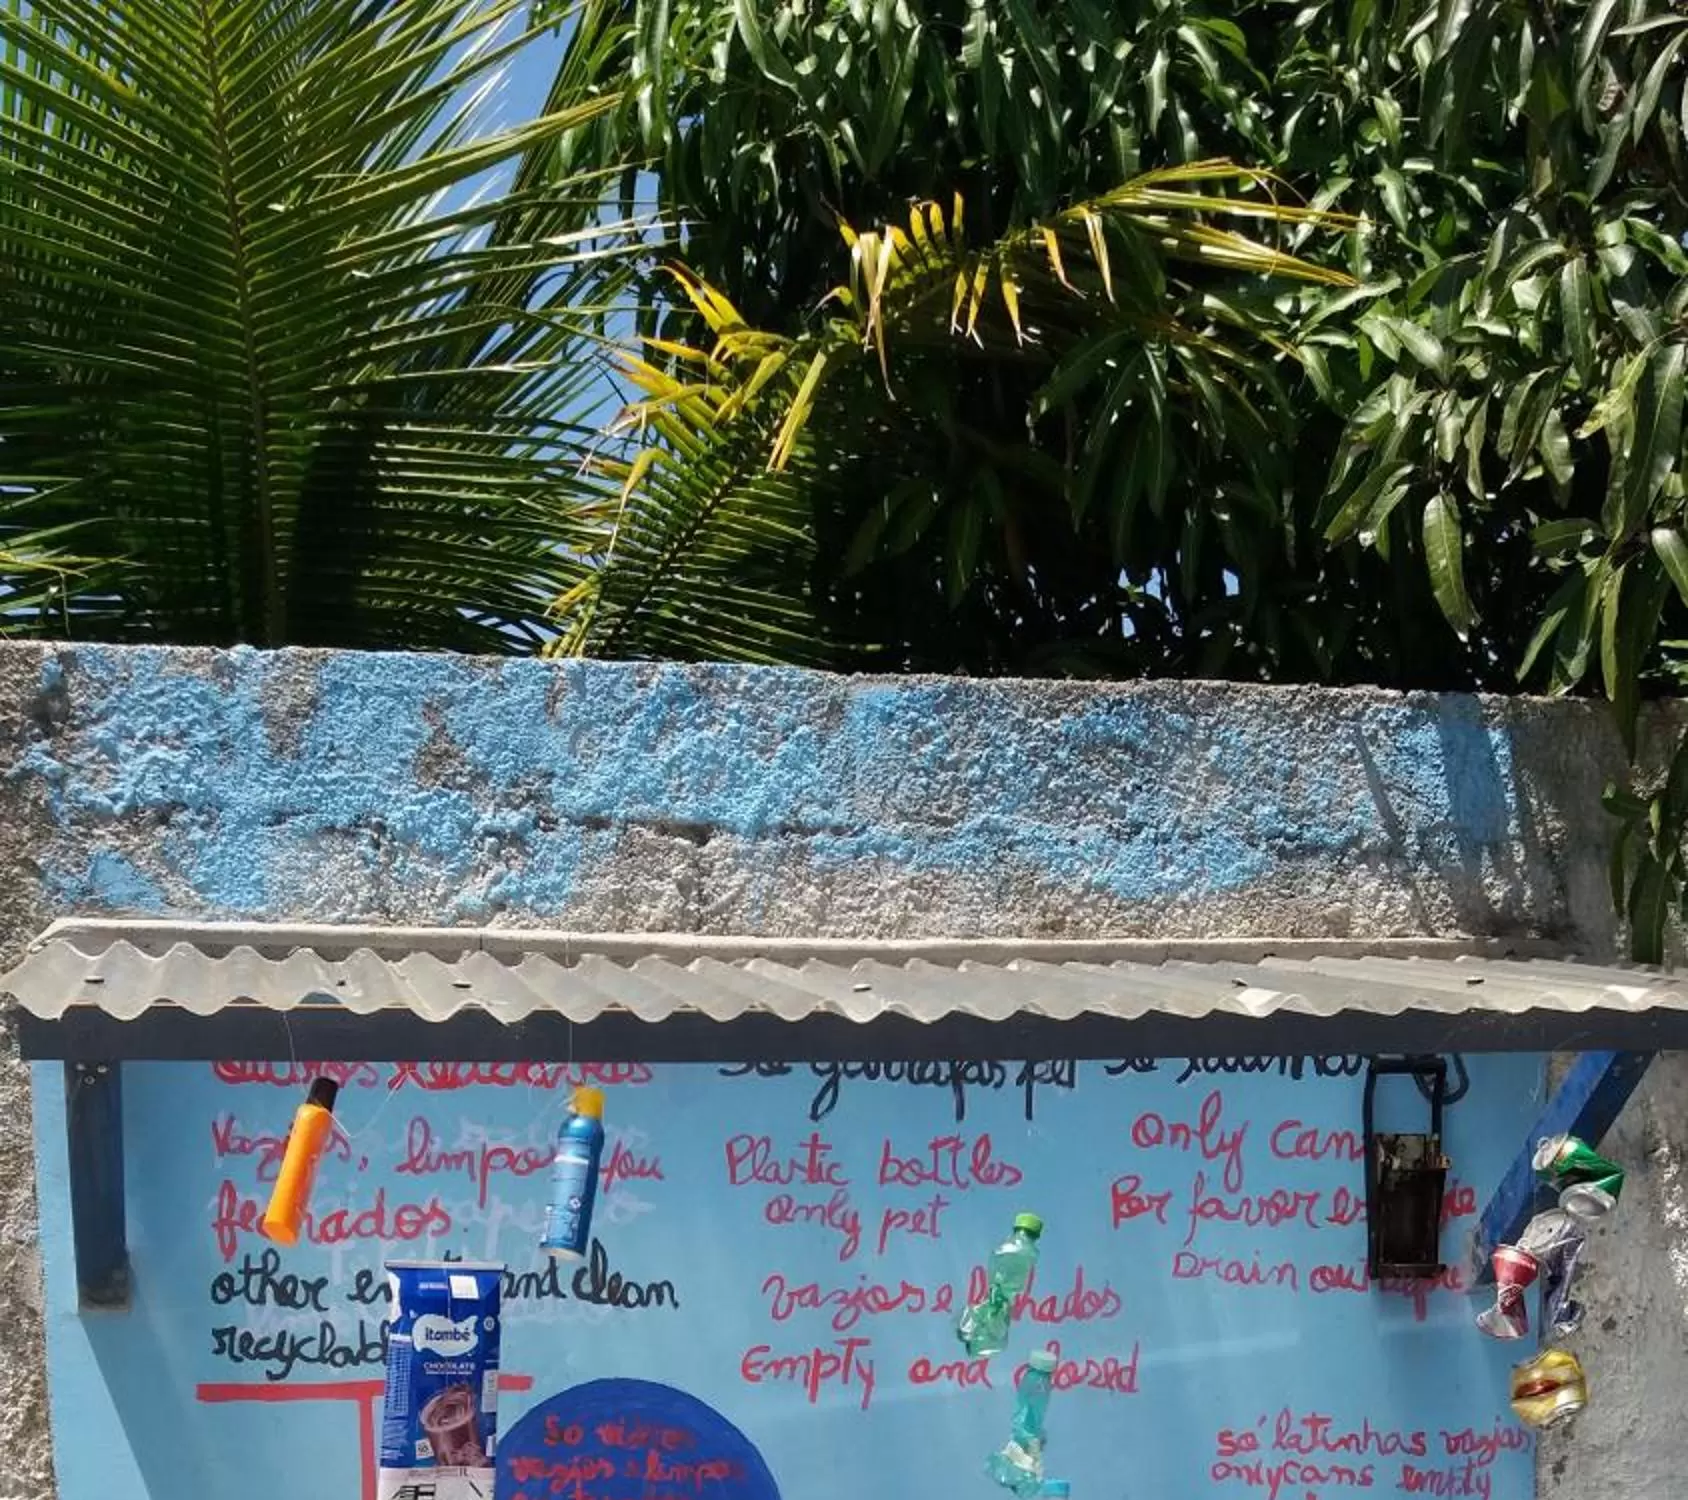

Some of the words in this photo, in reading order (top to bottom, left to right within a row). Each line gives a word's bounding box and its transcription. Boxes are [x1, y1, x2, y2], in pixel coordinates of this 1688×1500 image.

[725, 1131, 853, 1186] Plastic
[879, 1132, 1024, 1190] bottles
[1131, 1090, 1251, 1194] Only
[878, 1193, 949, 1255] pet
[1184, 1170, 1322, 1247] favor
[211, 1247, 330, 1312] other
[571, 1236, 680, 1311] clean
